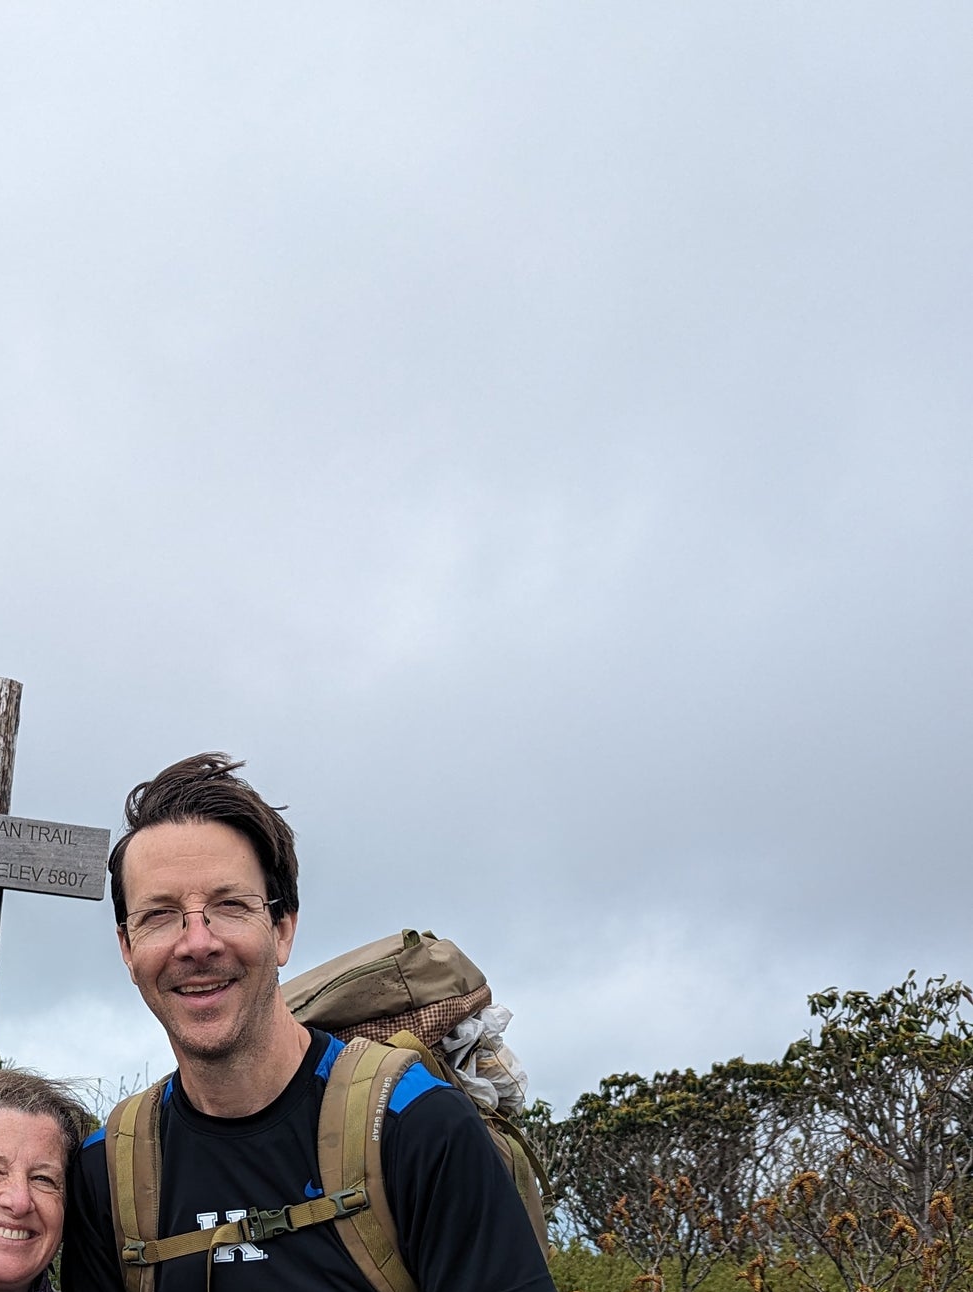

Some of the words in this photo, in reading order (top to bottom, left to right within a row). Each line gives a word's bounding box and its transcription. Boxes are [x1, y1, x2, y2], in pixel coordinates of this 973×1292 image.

[27, 823, 78, 846] TRAIL
[47, 869, 88, 888] 5807
[375, 1076, 393, 1115] GRANITE
[371, 1116, 382, 1142] GEAR
